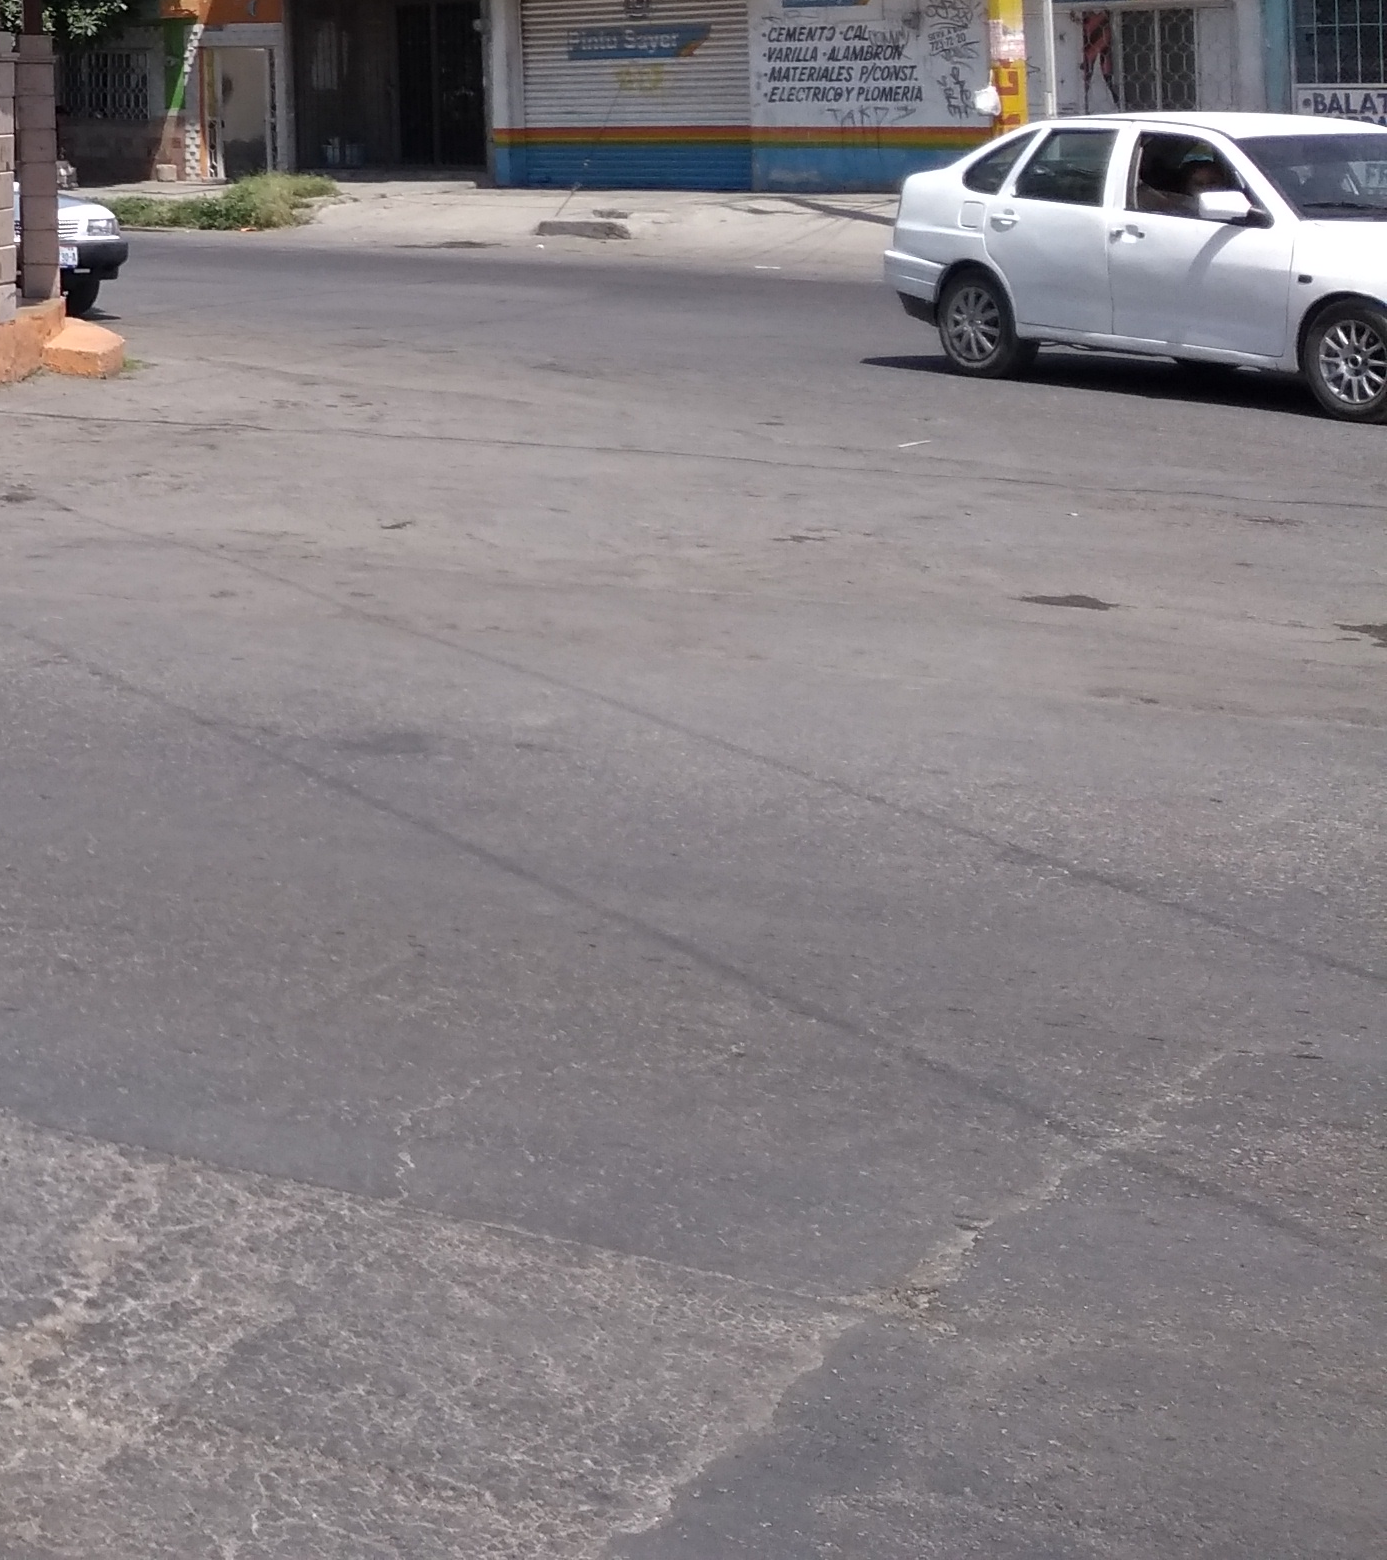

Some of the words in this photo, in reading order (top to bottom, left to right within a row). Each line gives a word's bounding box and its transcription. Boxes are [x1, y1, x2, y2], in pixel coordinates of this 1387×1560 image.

[768, 27, 836, 42] CEMENTO
[842, 25, 869, 41] CAL
[767, 47, 818, 62] VARILLA
[827, 45, 905, 62] ALAMBRON
[768, 66, 854, 82] MATERIALES
[859, 64, 918, 83] P/CONST.
[768, 87, 843, 102] ELECTRICO
[845, 86, 855, 101] Y
[856, 86, 924, 102] PLOMERIA
